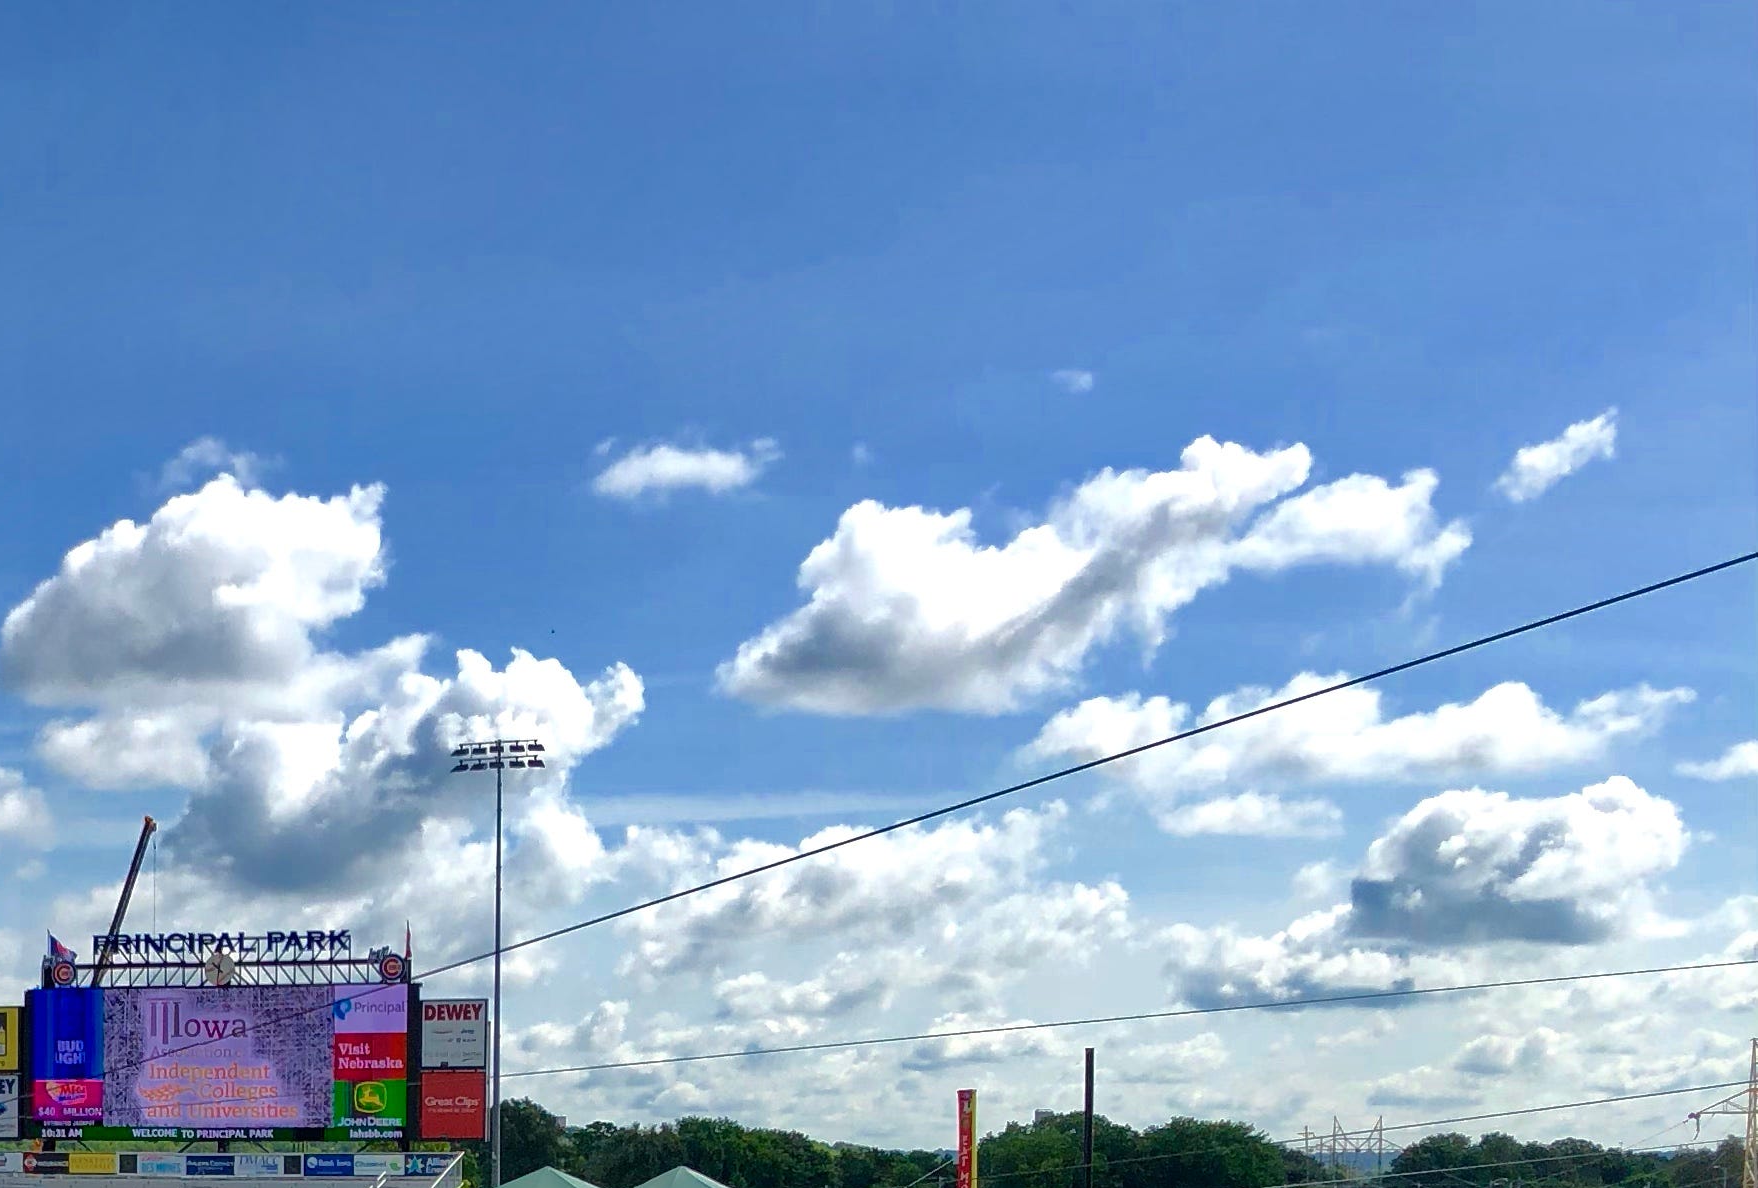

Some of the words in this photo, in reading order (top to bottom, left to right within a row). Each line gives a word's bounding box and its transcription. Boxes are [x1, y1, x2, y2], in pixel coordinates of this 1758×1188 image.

[93, 932, 255, 954] PRINCIPAL
[267, 930, 349, 951] PARK
[354, 1002, 404, 1015] Principal
[425, 1004, 483, 1020] DEWEY
[338, 1043, 371, 1055] Visit
[338, 1057, 404, 1069] Nebraska
[150, 1062, 270, 1083] Independent
[199, 1082, 278, 1101] Colleges
[425, 1097, 453, 1106] Great
[455, 1097, 479, 1106] Clips
[147, 1103, 181, 1117] and
[189, 1102, 299, 1118] Universities
[338, 1117, 367, 1127] JOHN
[368, 1117, 403, 1126] DEERE
[68, 1128, 83, 1137] AM
[132, 1128, 178, 1138] WELCOME
[181, 1129, 194, 1138] TO
[197, 1129, 246, 1139] PRINCIPAL
[249, 1129, 274, 1139] PARK
